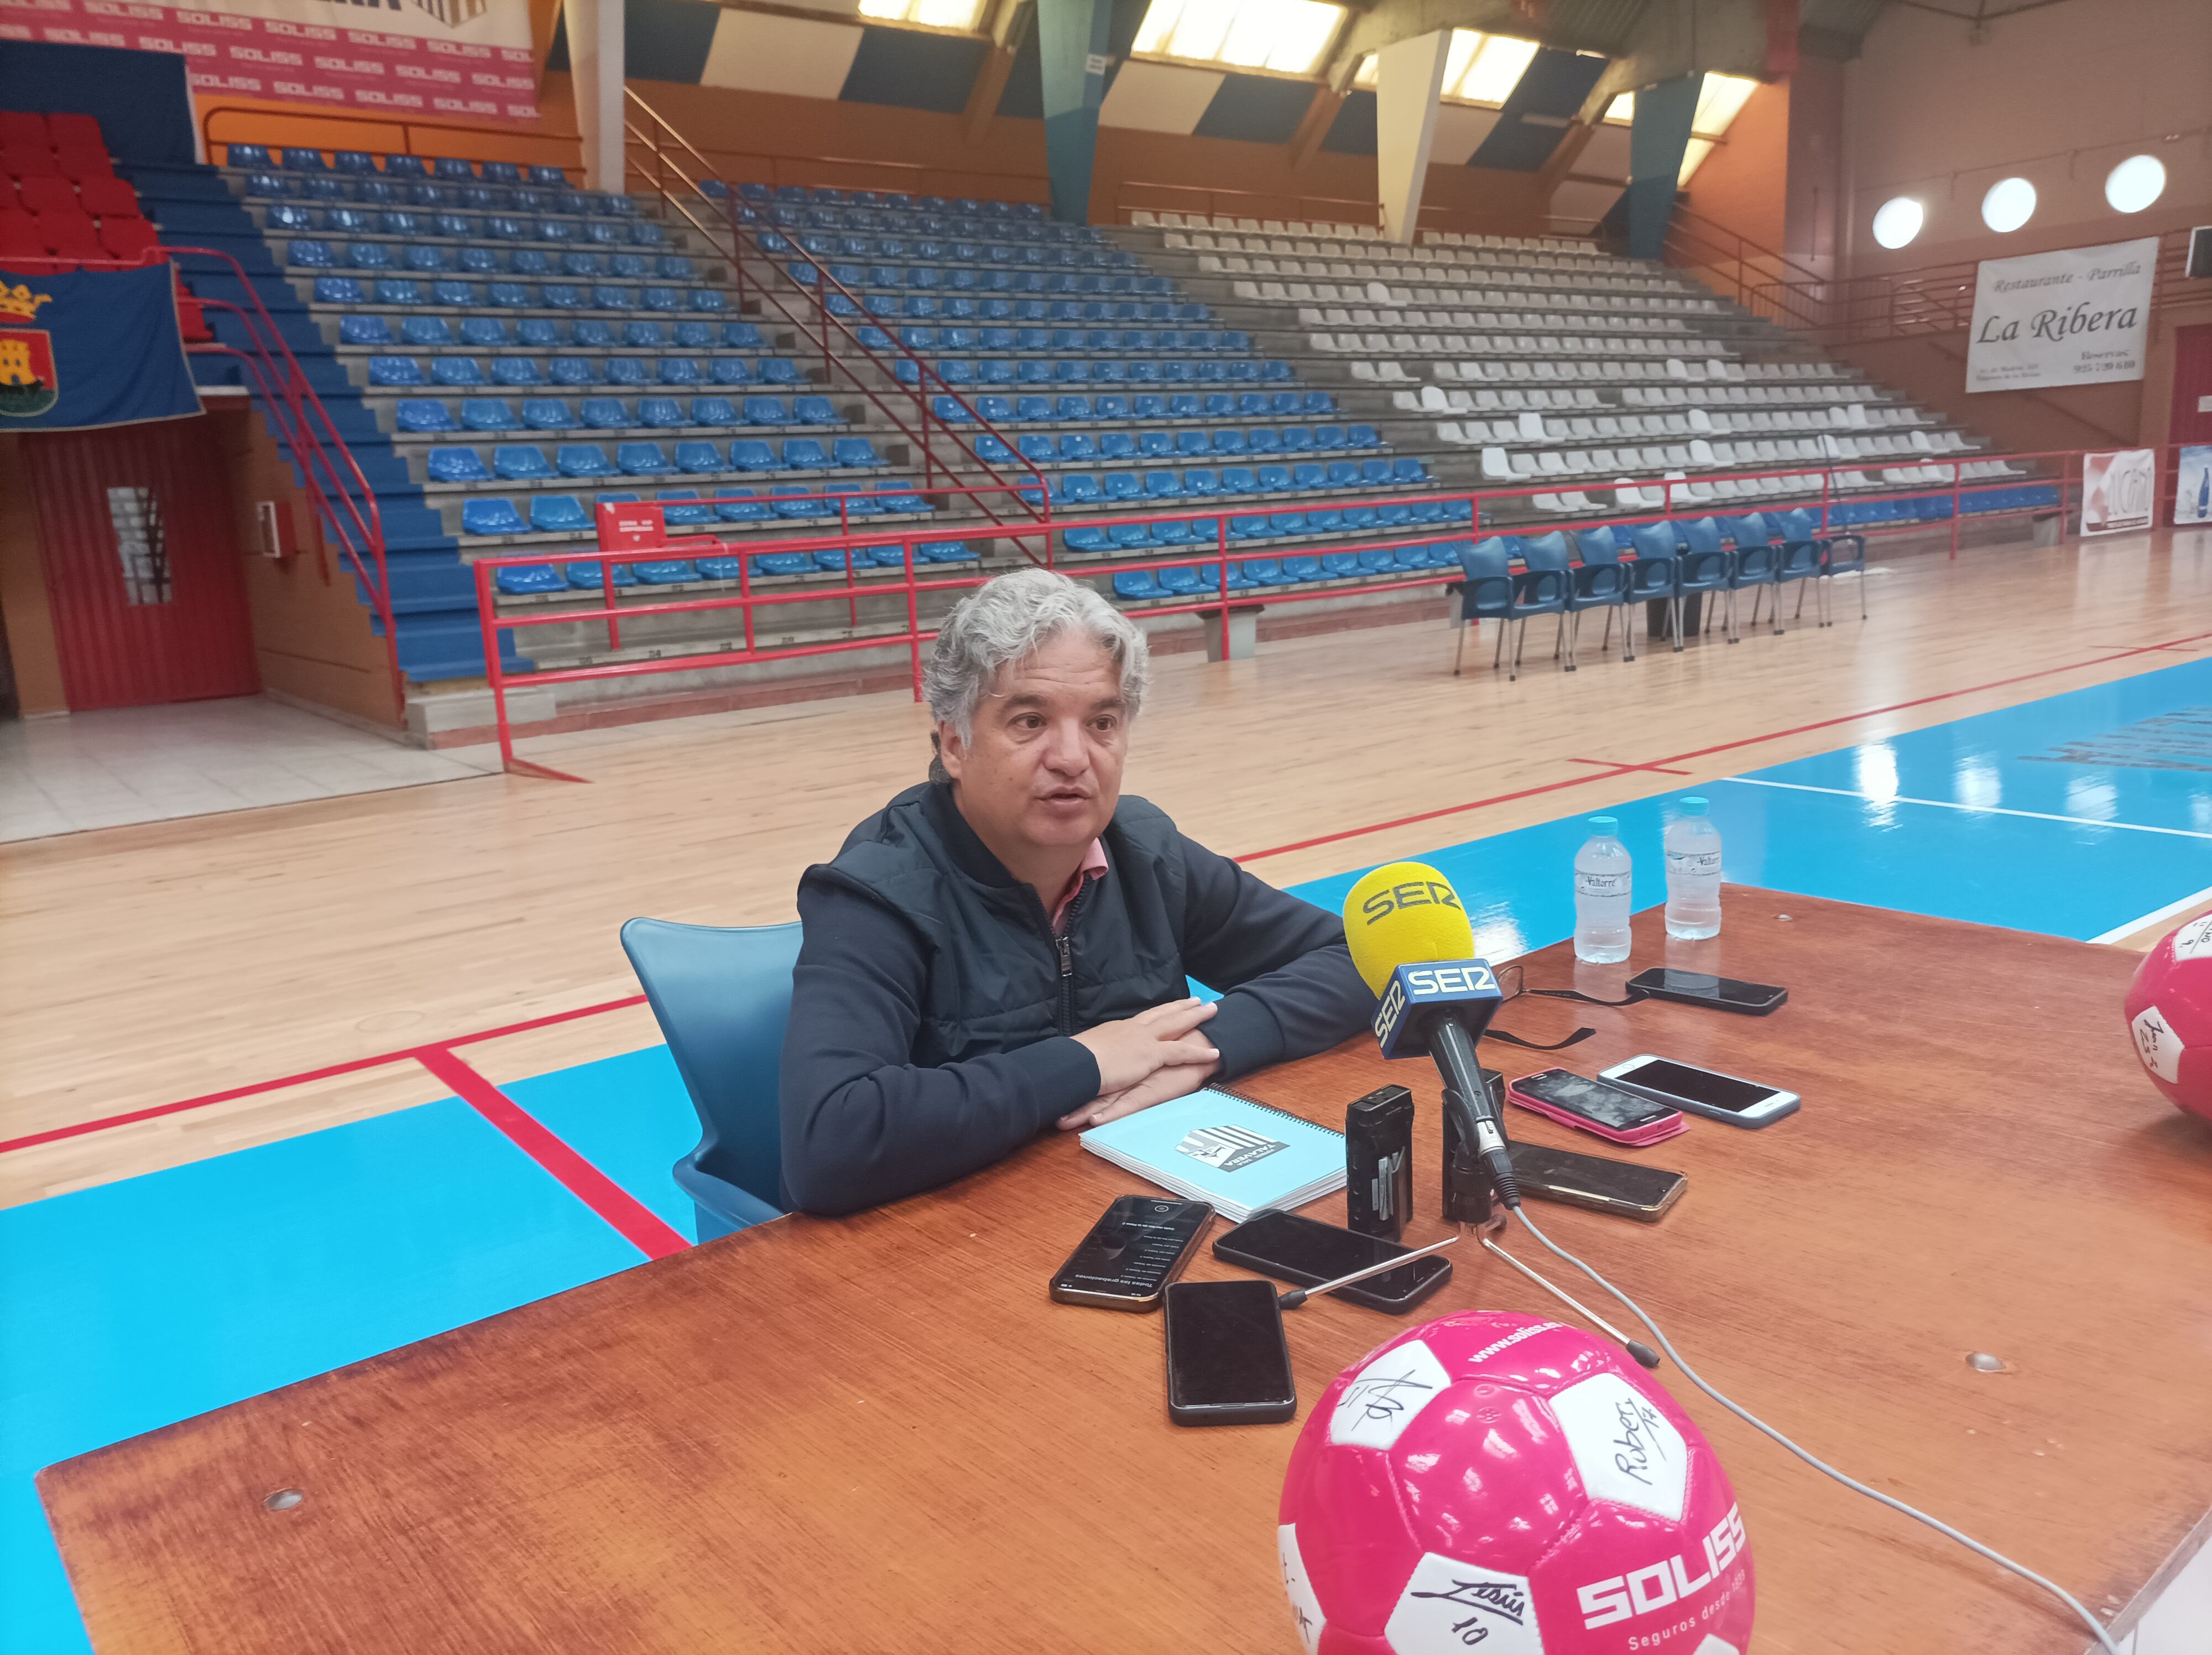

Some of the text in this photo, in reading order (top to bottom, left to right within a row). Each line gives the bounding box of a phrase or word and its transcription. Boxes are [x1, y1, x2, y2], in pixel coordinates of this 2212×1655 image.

[84, 2, 164, 20] SOLISS
[176, 11, 252, 30] SOLISS
[265, 20, 336, 40] SOLISS
[348, 30, 416, 49] SOLISS
[426, 40, 492, 58] SOLISS
[139, 36, 216, 56] SOLISS
[230, 46, 303, 66] SOLISS
[315, 56, 384, 75] SOLISS
[395, 65, 461, 84] SOLISS
[473, 74, 535, 90] SOLISS
[274, 81, 345, 99] SOLISS
[355, 90, 424, 108] SOLISS
[433, 97, 497, 115] SOLISS
[1994, 273, 2073, 293] Restaurante
[2088, 261, 2141, 281] Parrilla
[1976, 301, 2137, 344] La Ribera
[1363, 881, 1461, 926] SER
[1408, 966, 1496, 995] SER
[1375, 980, 1406, 1048] SER
[1224, 1144, 1276, 1166] TALAVERA
[1576, 1501, 1746, 1630] SOLISS
[1452, 1617, 1488, 1646] 10
[1628, 1617, 1695, 1651] Seguros
[1702, 1591, 1730, 1620] desde
